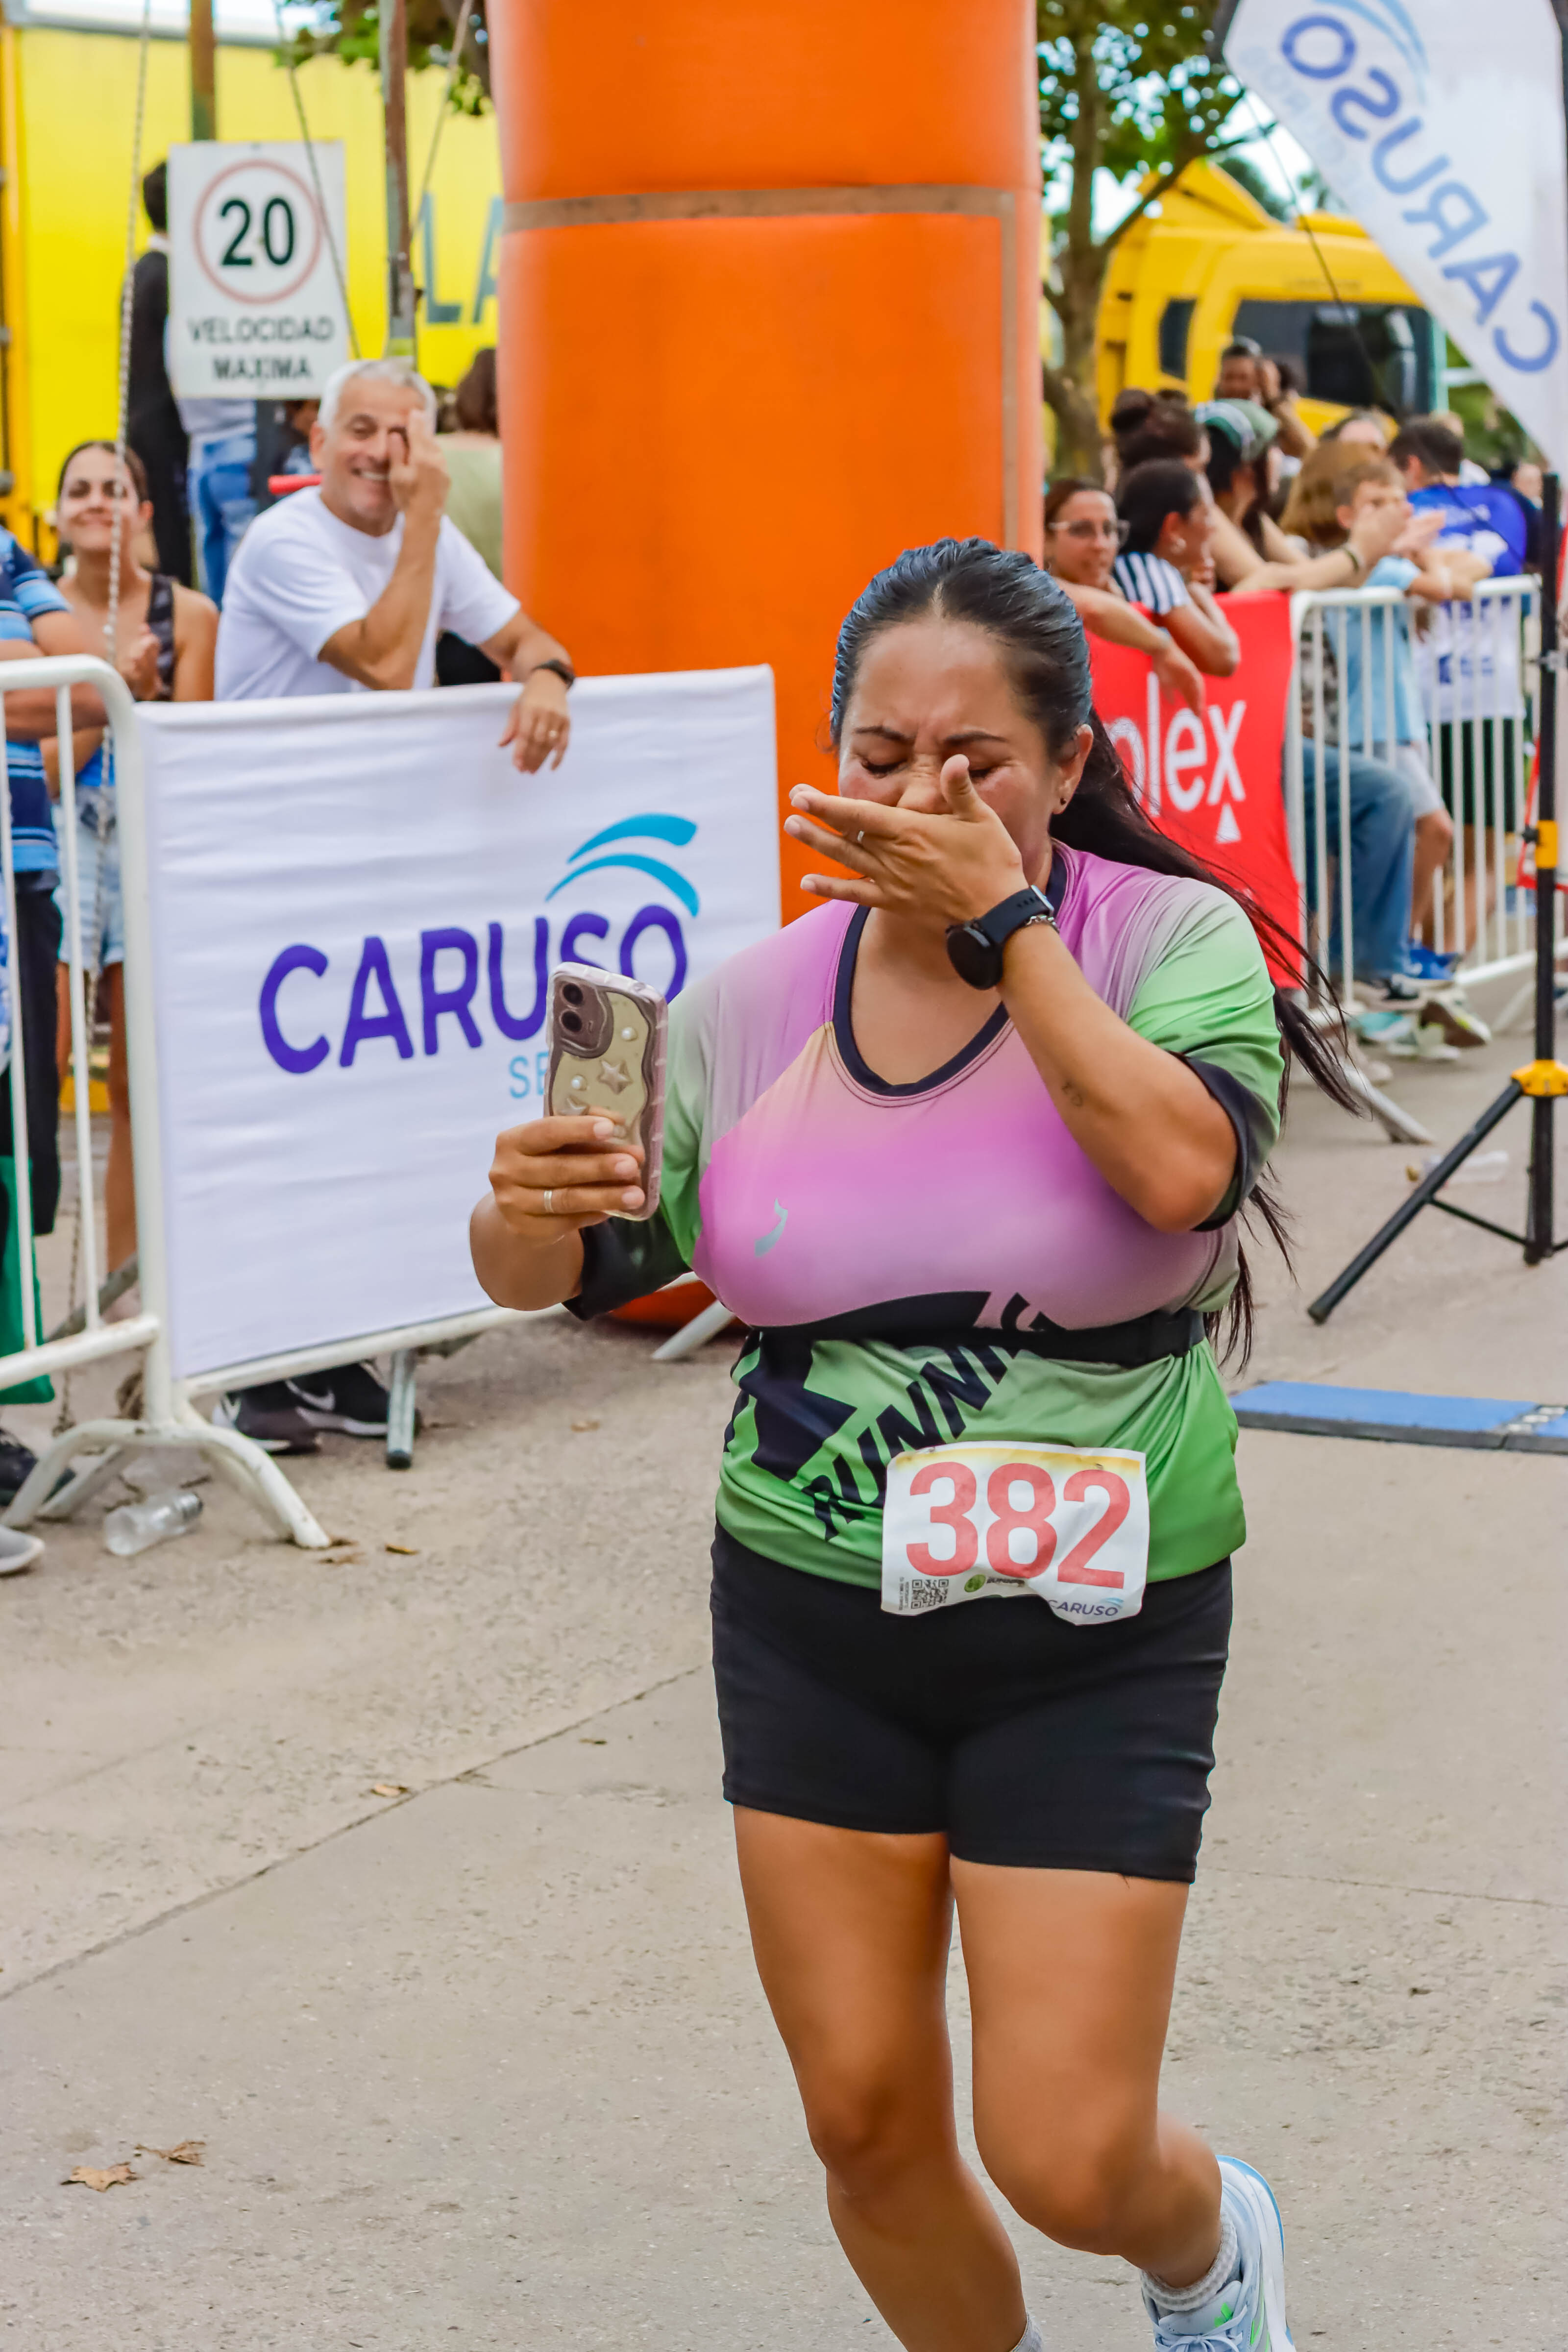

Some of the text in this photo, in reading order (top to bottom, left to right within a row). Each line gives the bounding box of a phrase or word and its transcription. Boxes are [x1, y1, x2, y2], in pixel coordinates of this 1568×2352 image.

[220, 197, 295, 266] 20
[188, 316, 335, 343] VELOCIDAD
[214, 355, 312, 380] MAXIMA
[802, 1292, 1066, 1542] RUNNIG
[906, 1462, 1130, 1589] 382
